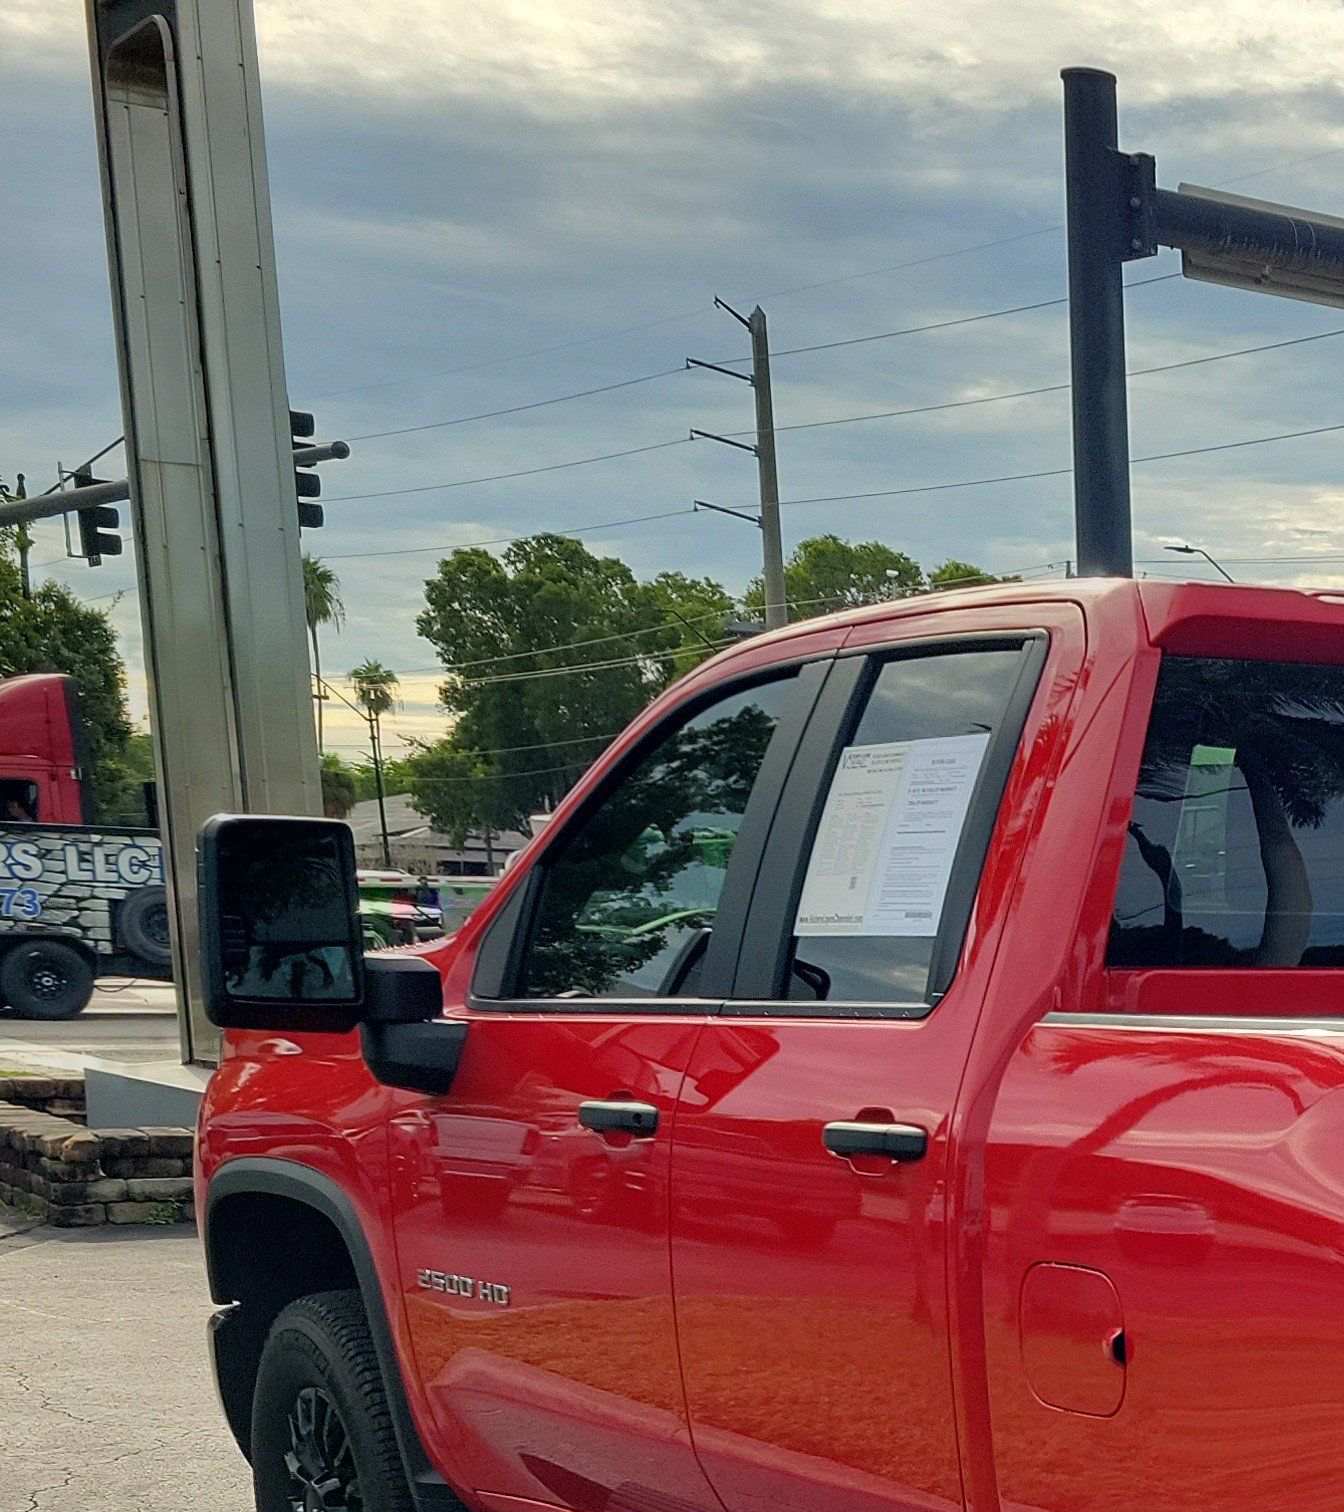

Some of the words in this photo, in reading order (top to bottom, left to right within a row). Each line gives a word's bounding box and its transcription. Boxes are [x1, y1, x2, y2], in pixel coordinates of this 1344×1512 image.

[63, 844, 152, 884] LLC
[418, 1268, 474, 1298] 2500
[479, 1280, 511, 1306] HD
